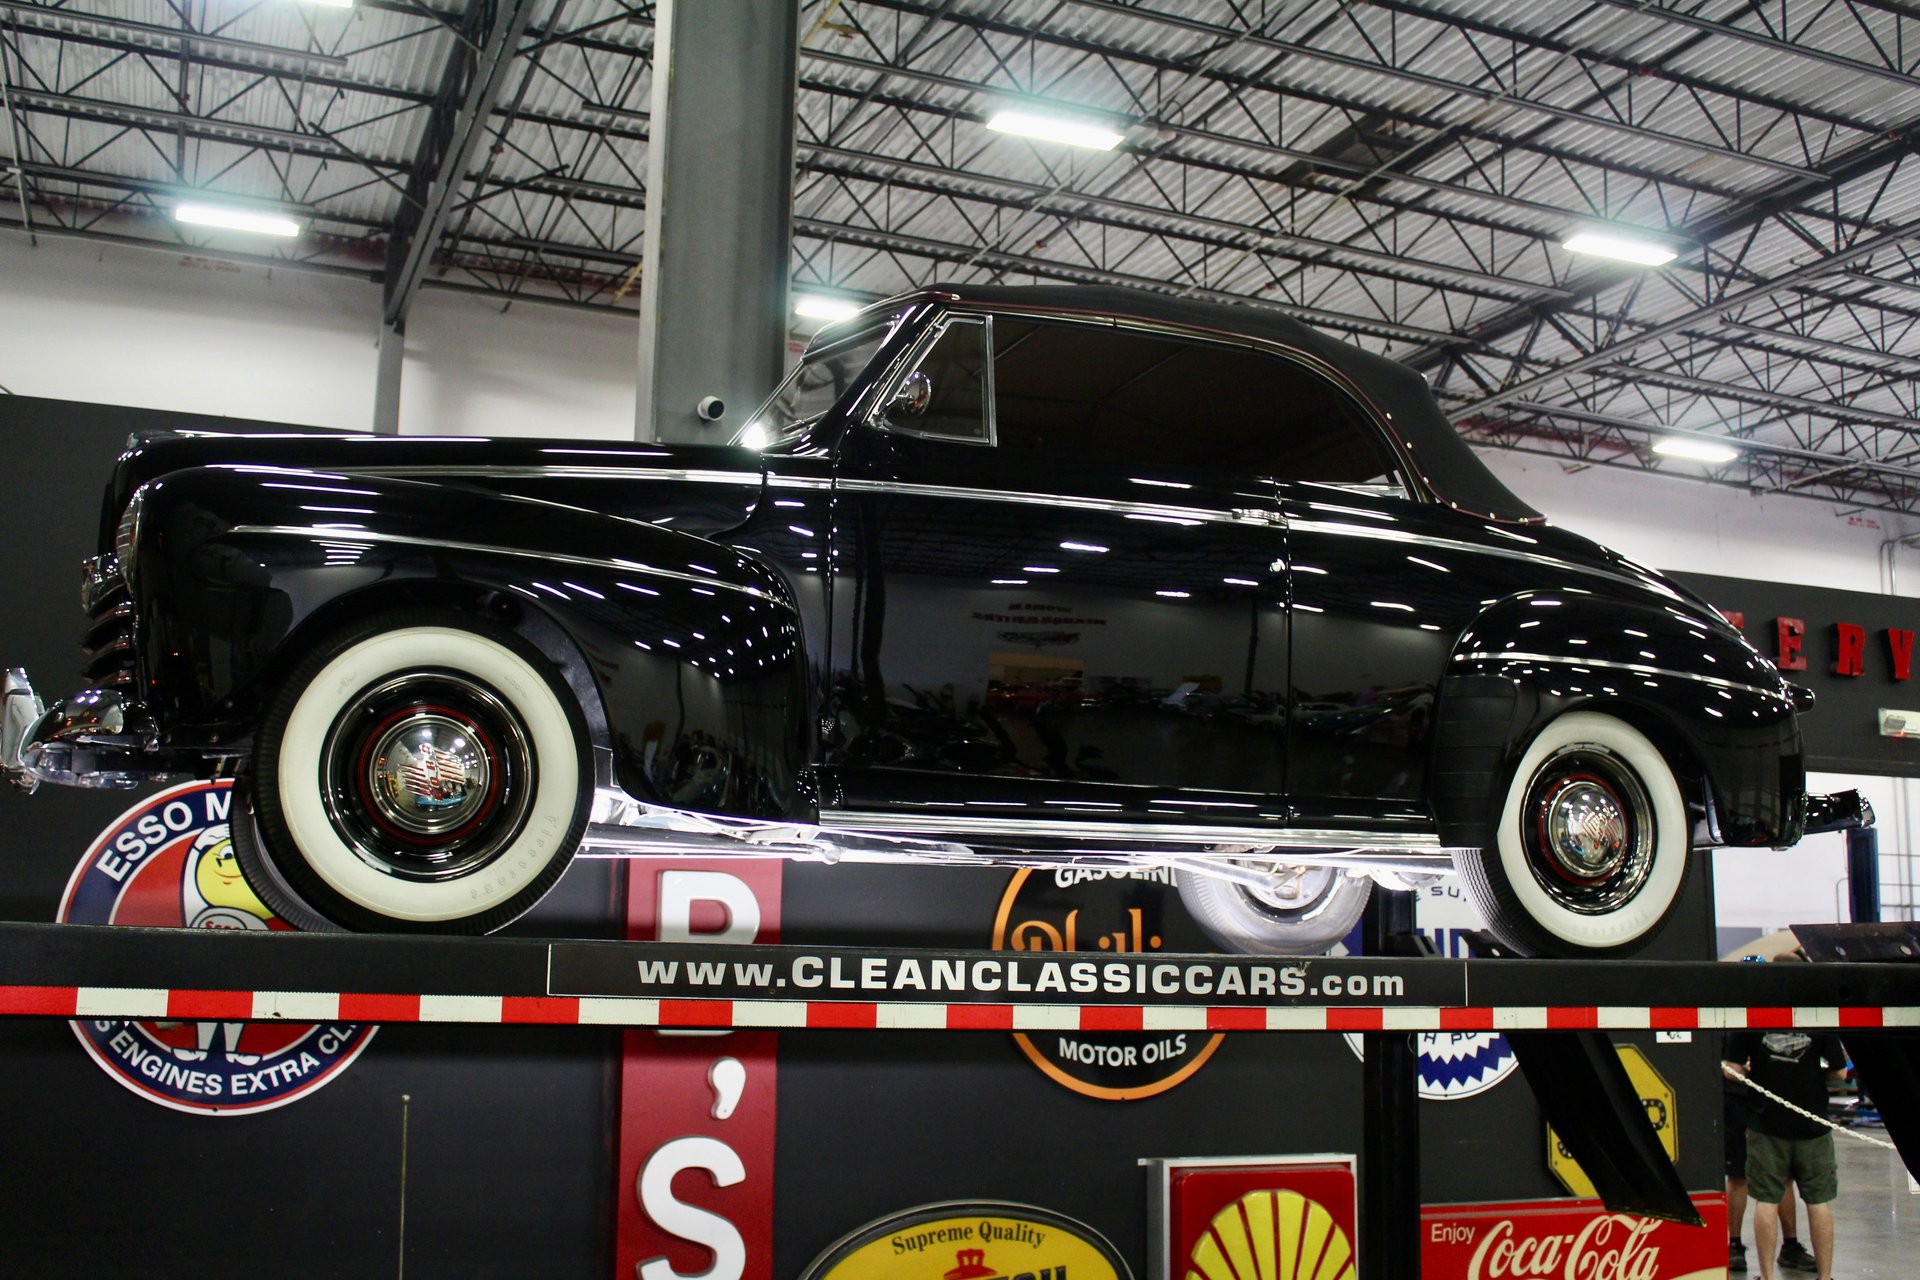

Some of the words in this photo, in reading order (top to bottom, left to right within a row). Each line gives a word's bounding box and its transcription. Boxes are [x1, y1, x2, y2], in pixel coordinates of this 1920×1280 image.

[96, 801, 193, 882] ESSO
[638, 956, 1404, 996] www.CLEANCLASSICCARS.com
[108, 1030, 223, 1096] ENGINES
[231, 1051, 320, 1095] EXTRA
[1059, 1036, 1138, 1067] MOTOR
[1142, 1033, 1187, 1064] OILS
[892, 1224, 974, 1255] Supreme
[978, 1220, 1046, 1250] Quality
[1431, 1222, 1476, 1244] Enjoy
[1467, 1213, 1664, 1280] Coca-Cola
